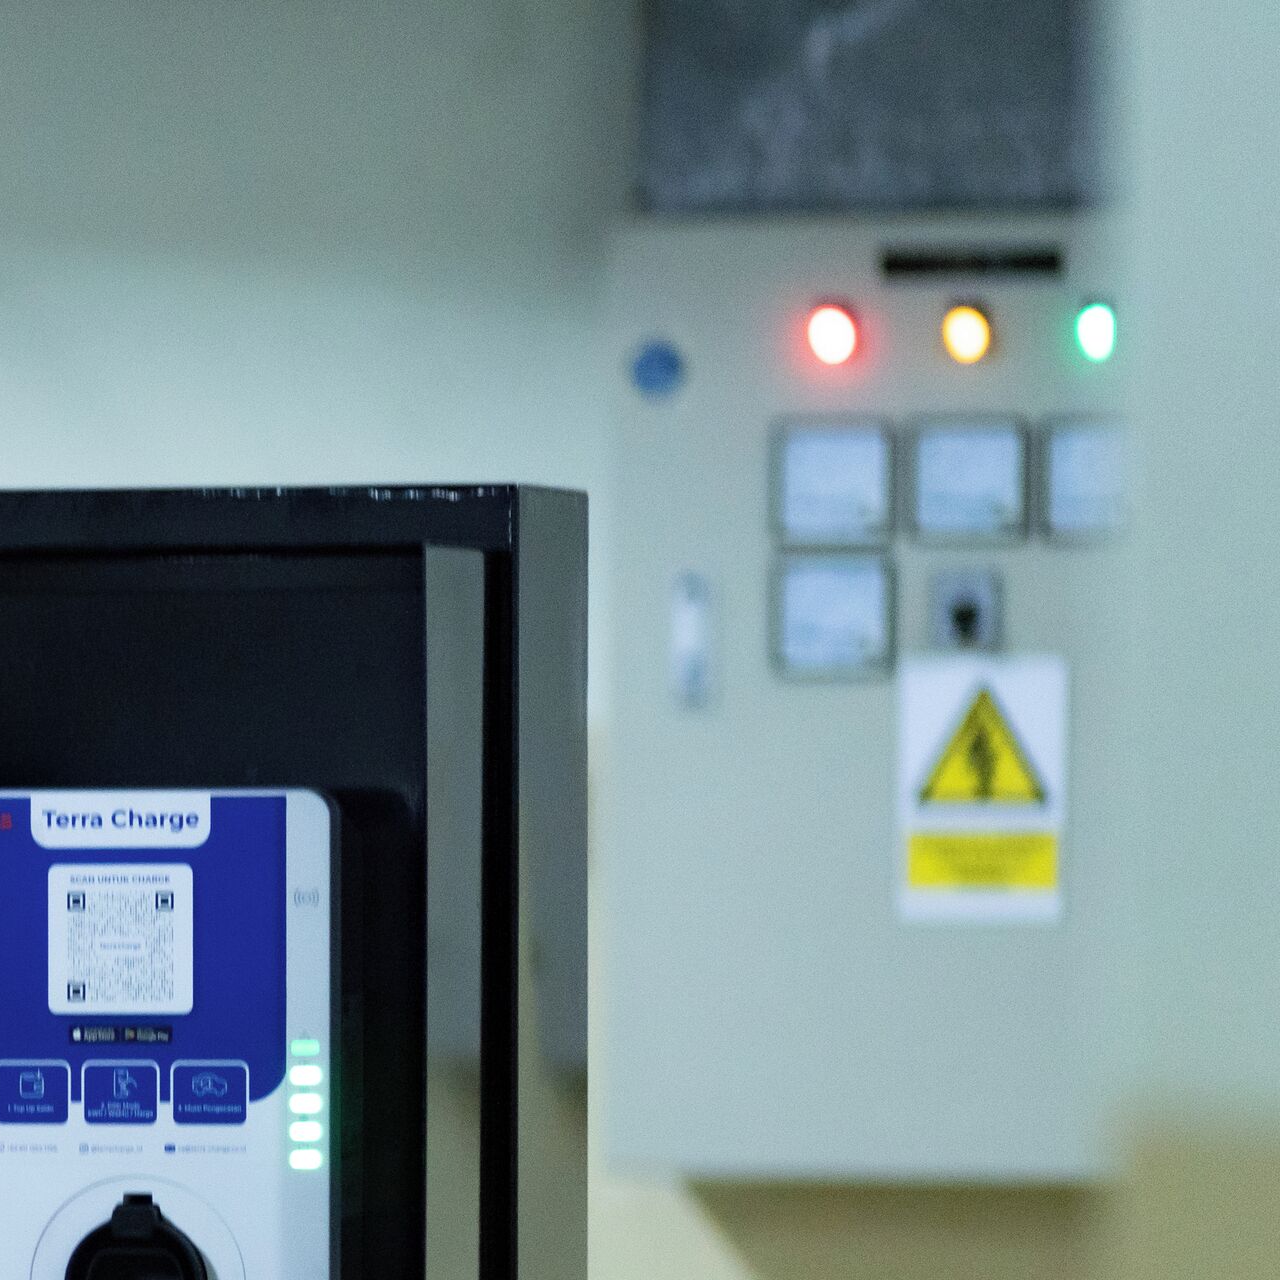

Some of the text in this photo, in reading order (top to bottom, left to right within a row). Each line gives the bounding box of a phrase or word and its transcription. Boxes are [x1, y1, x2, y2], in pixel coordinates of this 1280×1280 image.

[42, 808, 200, 834] Terra Charge
[132, 874, 170, 885] CHARGE
